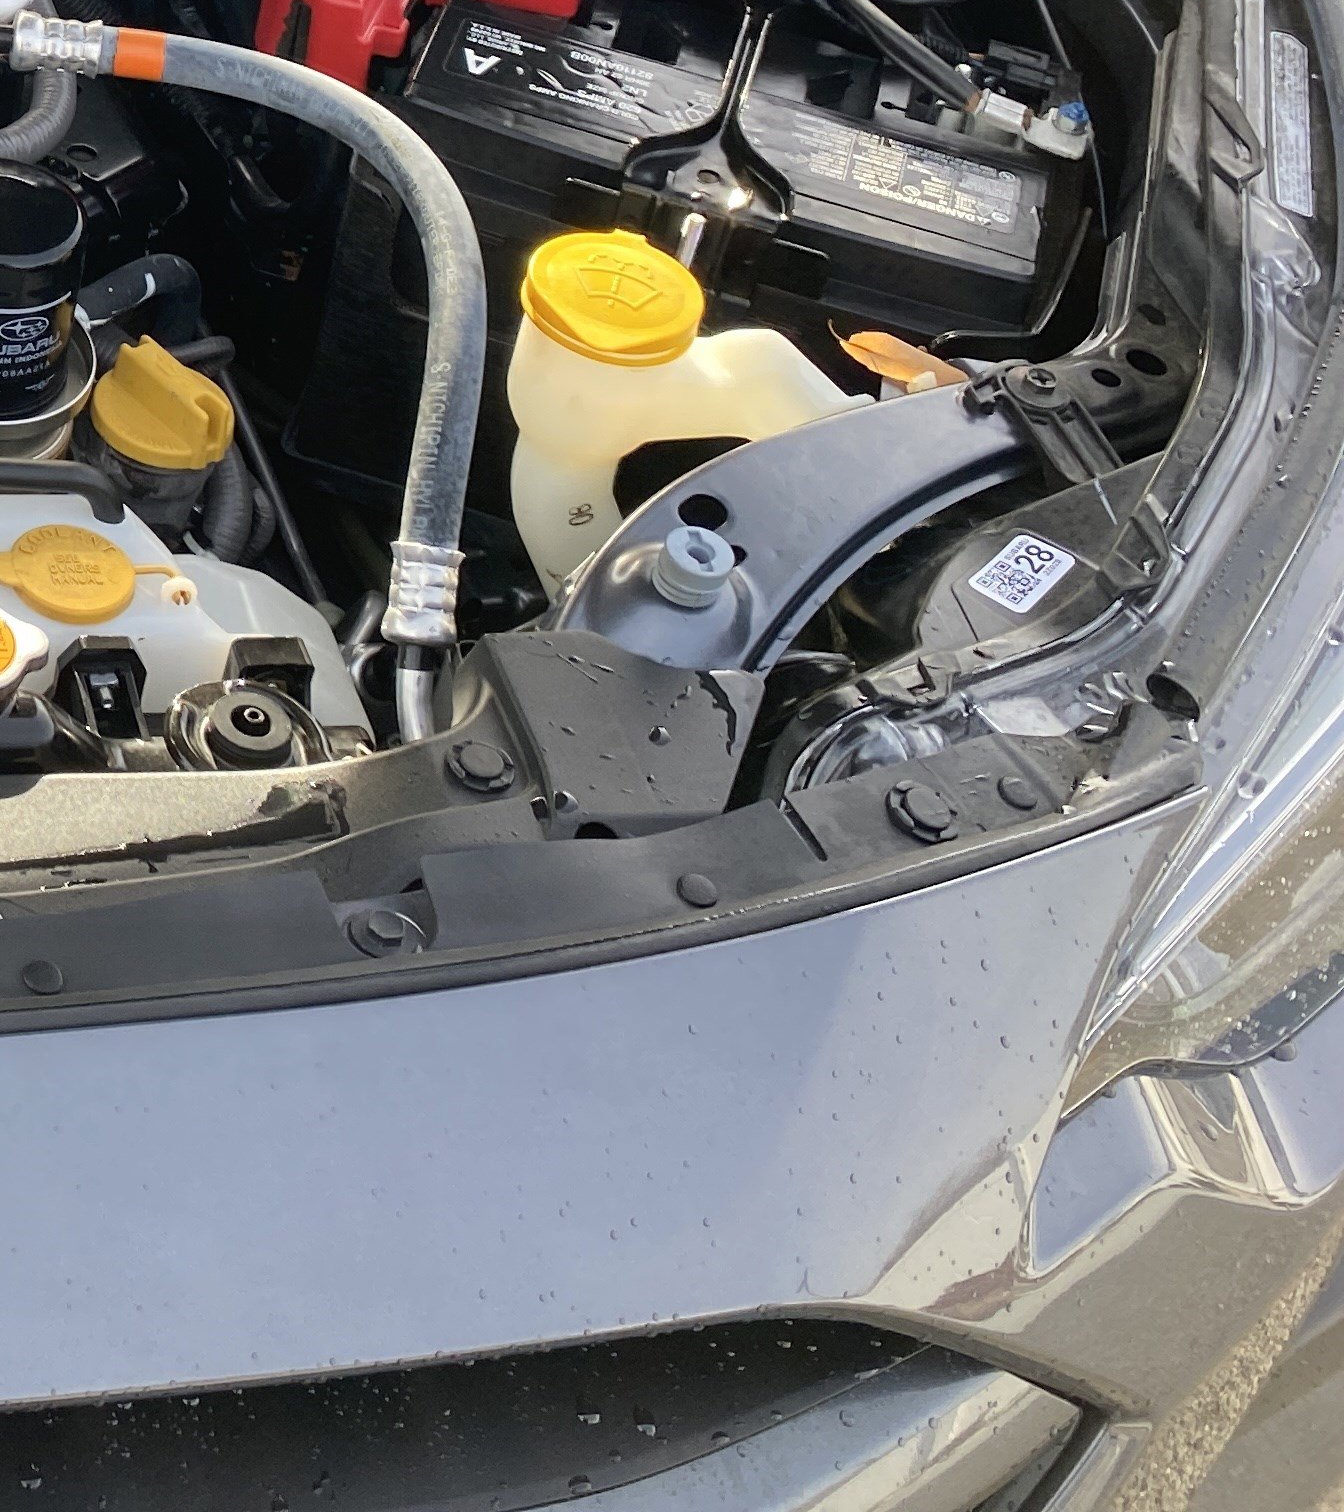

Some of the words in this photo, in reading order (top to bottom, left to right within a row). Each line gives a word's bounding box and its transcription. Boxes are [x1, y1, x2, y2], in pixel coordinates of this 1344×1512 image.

[463, 47, 502, 76] A
[529, 83, 558, 96] AMPS
[577, 89, 614, 106] AMPS
[559, 93, 611, 112] CRANKING
[859, 182, 976, 223] DANGER/POISON
[0, 356, 12, 365] IN
[19, 526, 117, 555] COOLANT
[1014, 545, 1054, 574] 28
[51, 575, 104, 586] MANUAL
